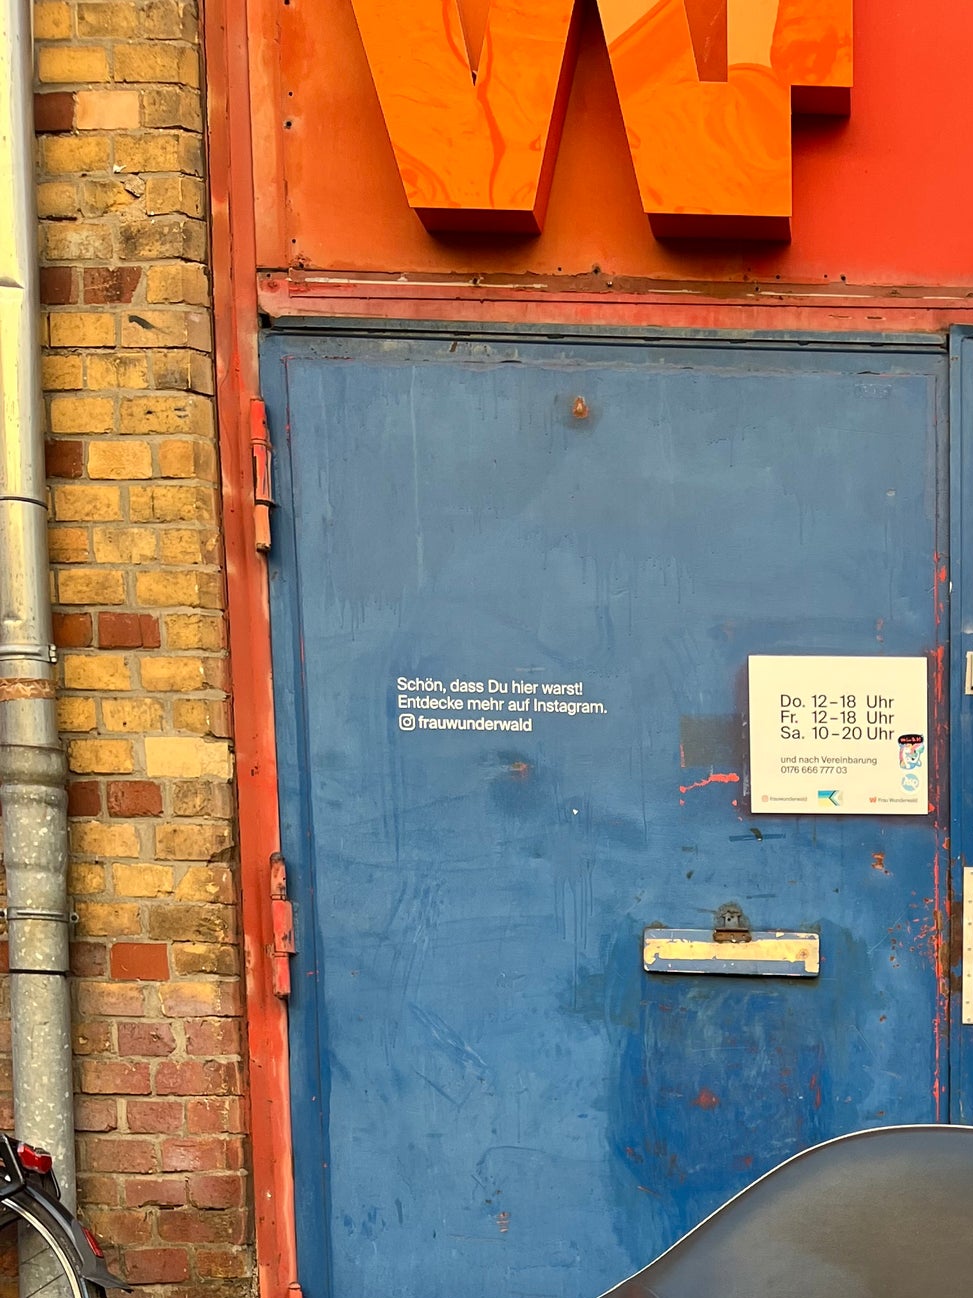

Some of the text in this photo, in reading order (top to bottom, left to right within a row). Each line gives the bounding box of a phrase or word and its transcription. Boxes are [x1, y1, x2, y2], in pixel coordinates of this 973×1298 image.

[397, 676, 583, 696] Schön, dass Du hier warst!
[397, 694, 608, 716] Entdecke mehr auf Instagram.
[780, 694, 805, 708] Do.
[866, 694, 895, 709] Uhr
[418, 715, 533, 732] frauwunderwald
[780, 710, 798, 724] Fr.
[866, 710, 895, 725] Uhr
[780, 725, 805, 740] Sa.
[866, 726, 895, 741] Uhr
[780, 755, 878, 766] und nach Vereinbarung
[780, 765, 848, 775] 0176 666 777 03
